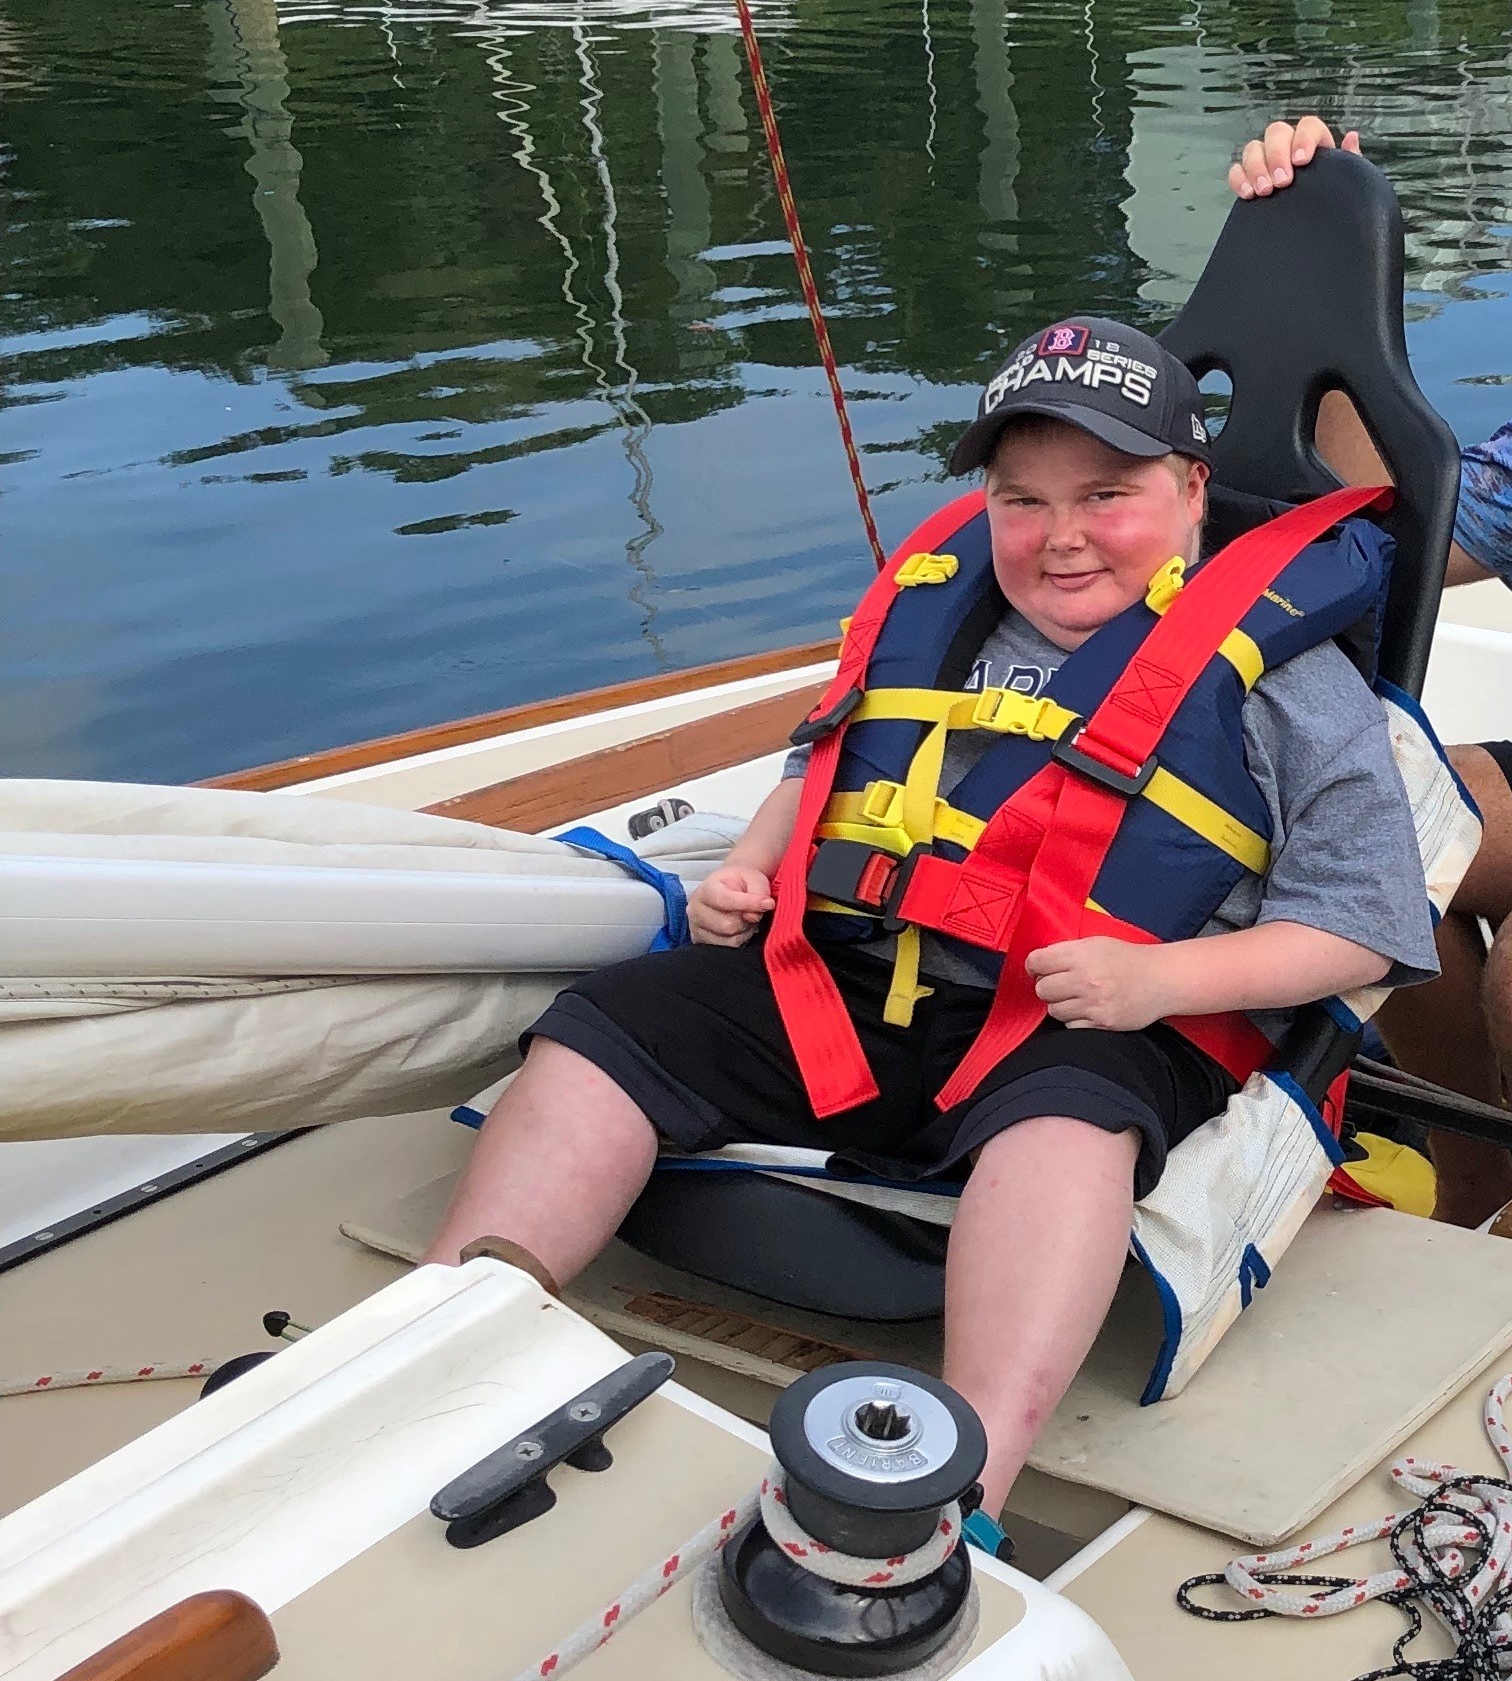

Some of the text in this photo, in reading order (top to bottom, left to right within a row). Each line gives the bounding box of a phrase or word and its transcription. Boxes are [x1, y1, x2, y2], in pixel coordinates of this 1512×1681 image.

[1087, 349, 1158, 380] SERIES
[984, 357, 1152, 415] CHAMPS
[831, 1442, 922, 1471] BARIENT
